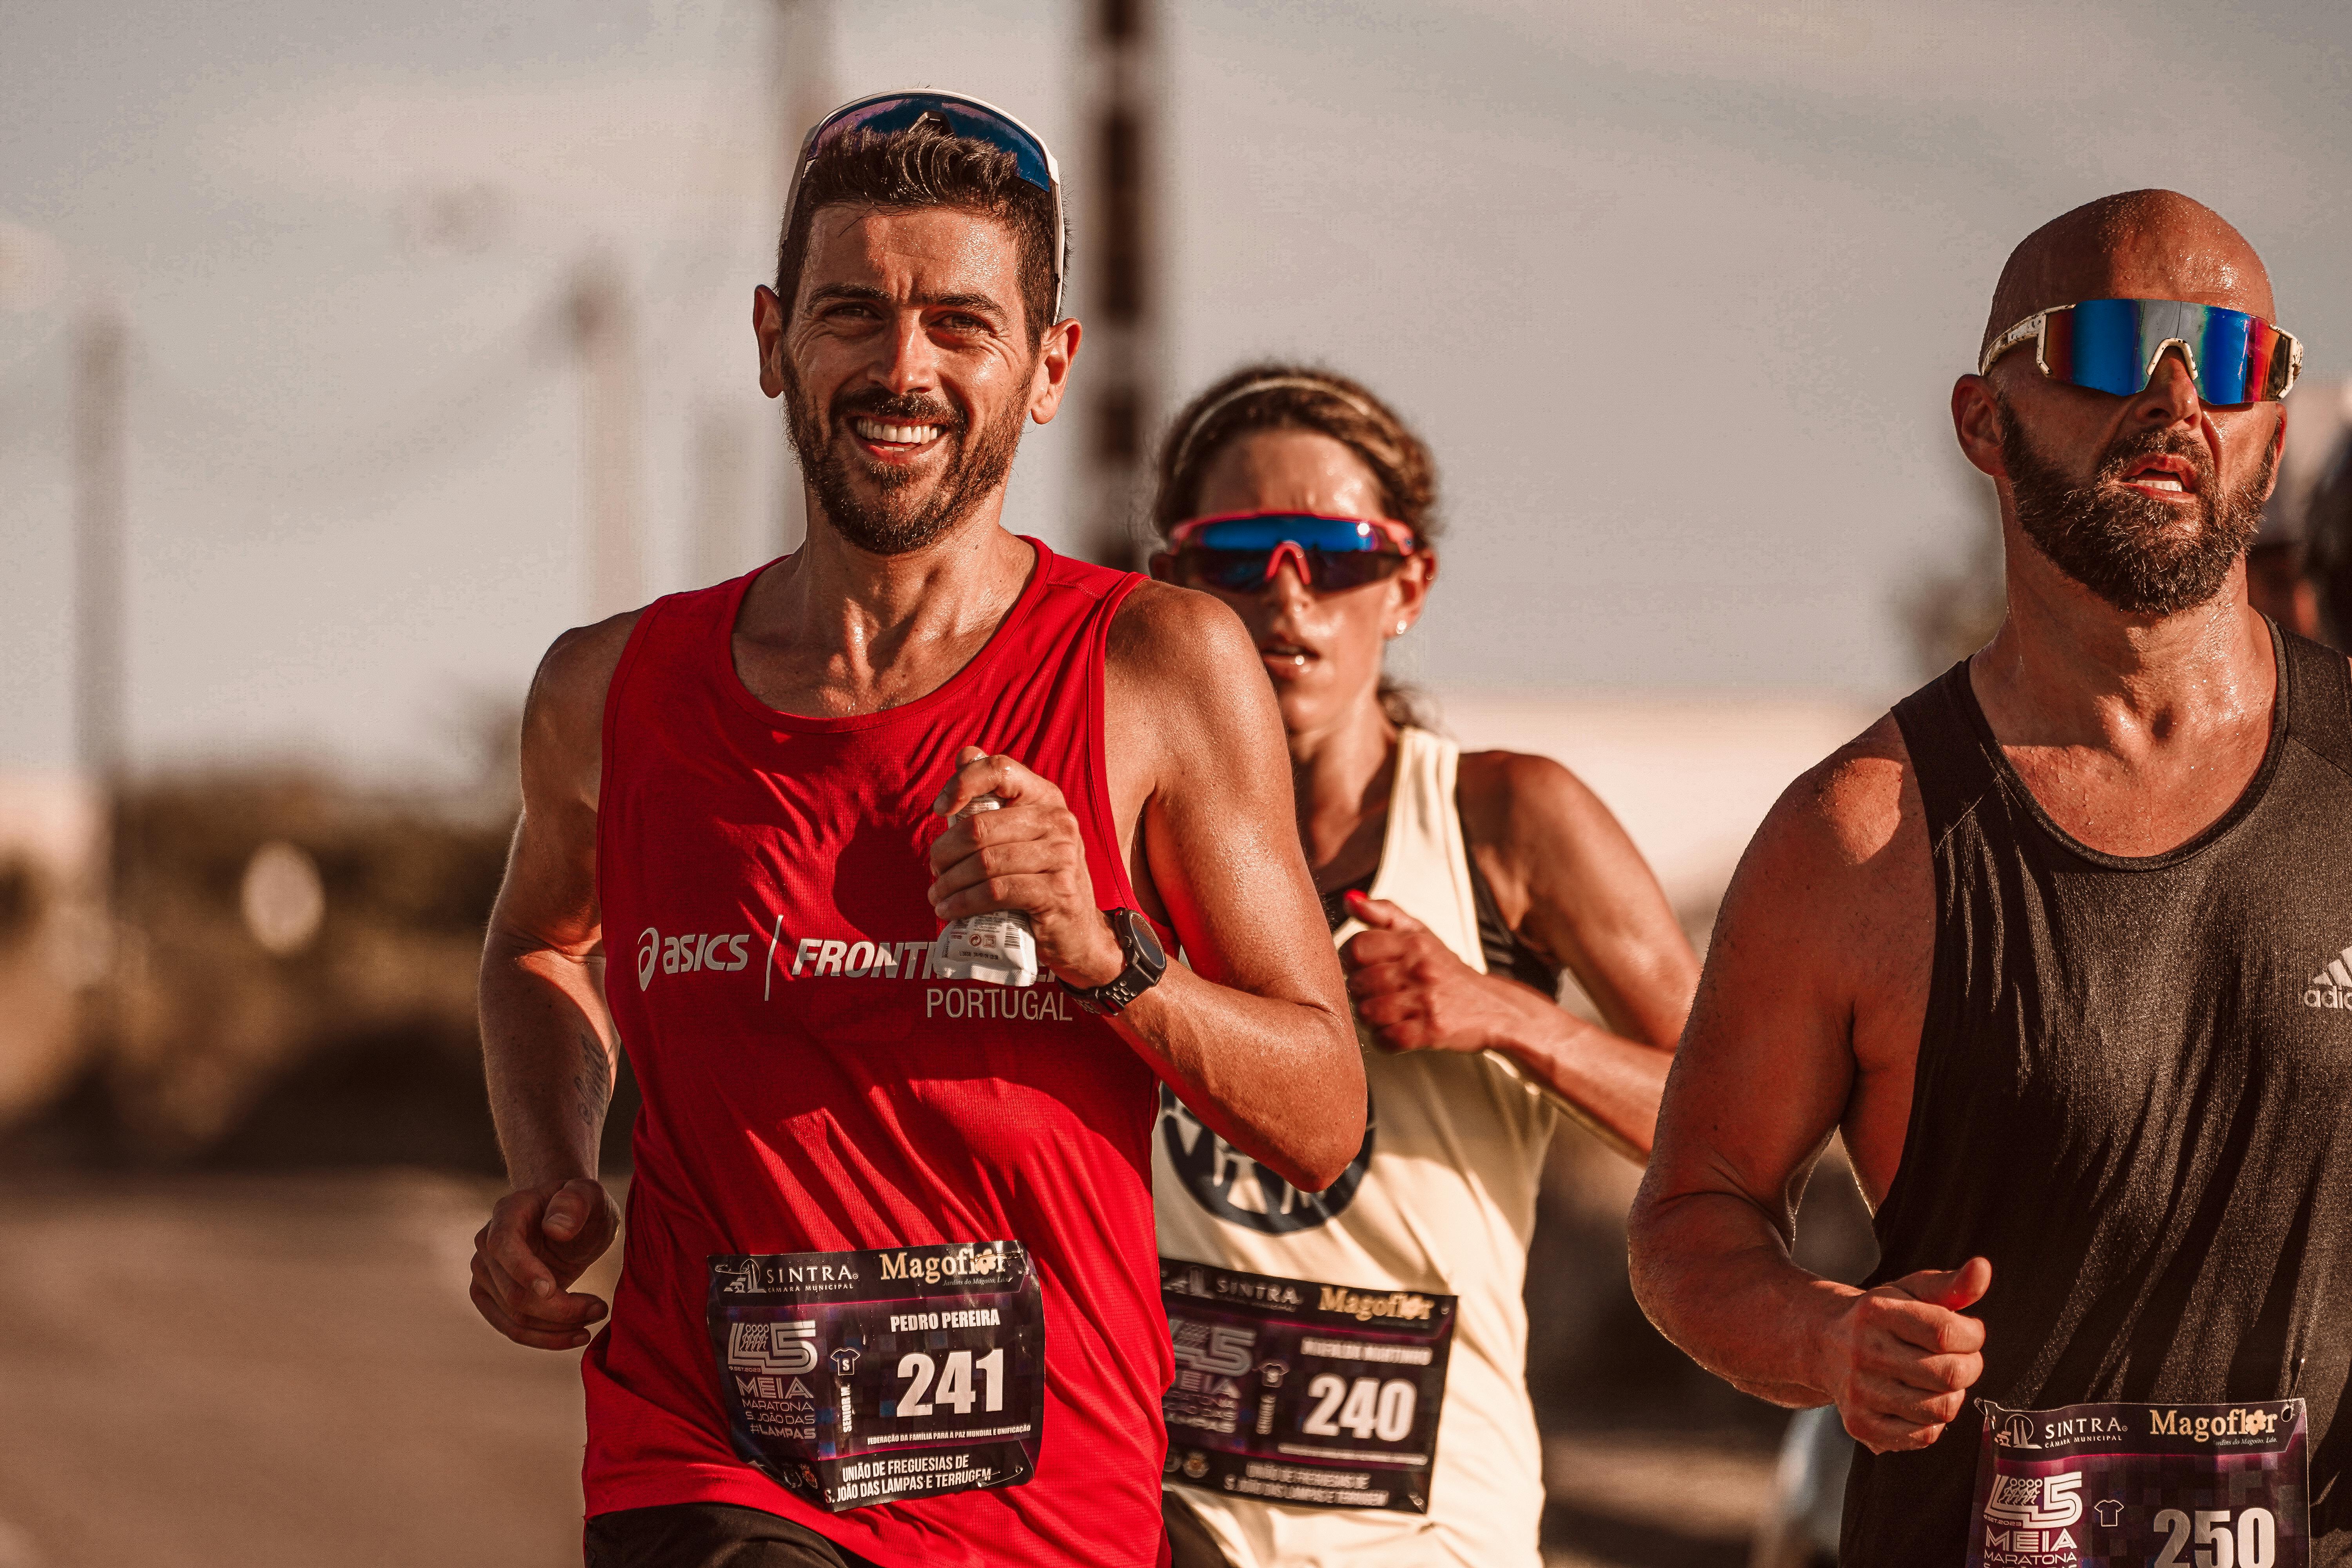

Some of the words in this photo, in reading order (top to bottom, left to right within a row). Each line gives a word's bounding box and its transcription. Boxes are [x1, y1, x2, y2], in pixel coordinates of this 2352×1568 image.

[663, 934, 750, 975] asics
[927, 988, 1073, 1021] PORTUGAL
[767, 1265, 853, 1284] SINTRA
[805, 1283, 854, 1292] MUNICIPAL
[1216, 1278, 1300, 1304] SINTRA
[890, 1312, 939, 1332] PEDRO
[942, 1308, 1001, 1329] PEREIRA
[842, 1358, 850, 1372] S
[735, 1376, 814, 1399] MEIA
[897, 1348, 1004, 1417] 241
[742, 1398, 815, 1412] MARATONA
[1302, 1372, 1417, 1442] 240
[745, 1411, 755, 1421] S.
[757, 1412, 784, 1424] JOÃO
[785, 1415, 815, 1425] DAS
[2045, 1417, 2122, 1439] SINTRA
[750, 1423, 816, 1440] #LAMPAS
[867, 1432, 899, 1445] FEDERAÇÃO
[900, 1433, 909, 1442] DA
[933, 1431, 949, 1440] PARA
[949, 1430, 954, 1439] A
[955, 1430, 966, 1438] PAZ
[966, 1428, 993, 1438] MUNDIAL
[997, 1424, 1031, 1436] UNIFICAÇÃO
[2073, 1435, 2122, 1443] MUNICIPAL
[842, 1462, 871, 1483] UNIÃO
[873, 1460, 886, 1477] DE
[887, 1455, 953, 1475] FREGUESIAS
[955, 1454, 969, 1469] DE
[824, 1488, 835, 1503] S.
[837, 1480, 858, 1502] JOÃO
[860, 1481, 880, 1497] DAS
[881, 1474, 924, 1494] LAMPAS
[926, 1475, 933, 1488] E
[935, 1467, 992, 1488] TERRUGEM
[1985, 1525, 2077, 1553] MEIA
[2153, 1507, 2275, 1568] 250
[1984, 1548, 2077, 1565] MARATONA
